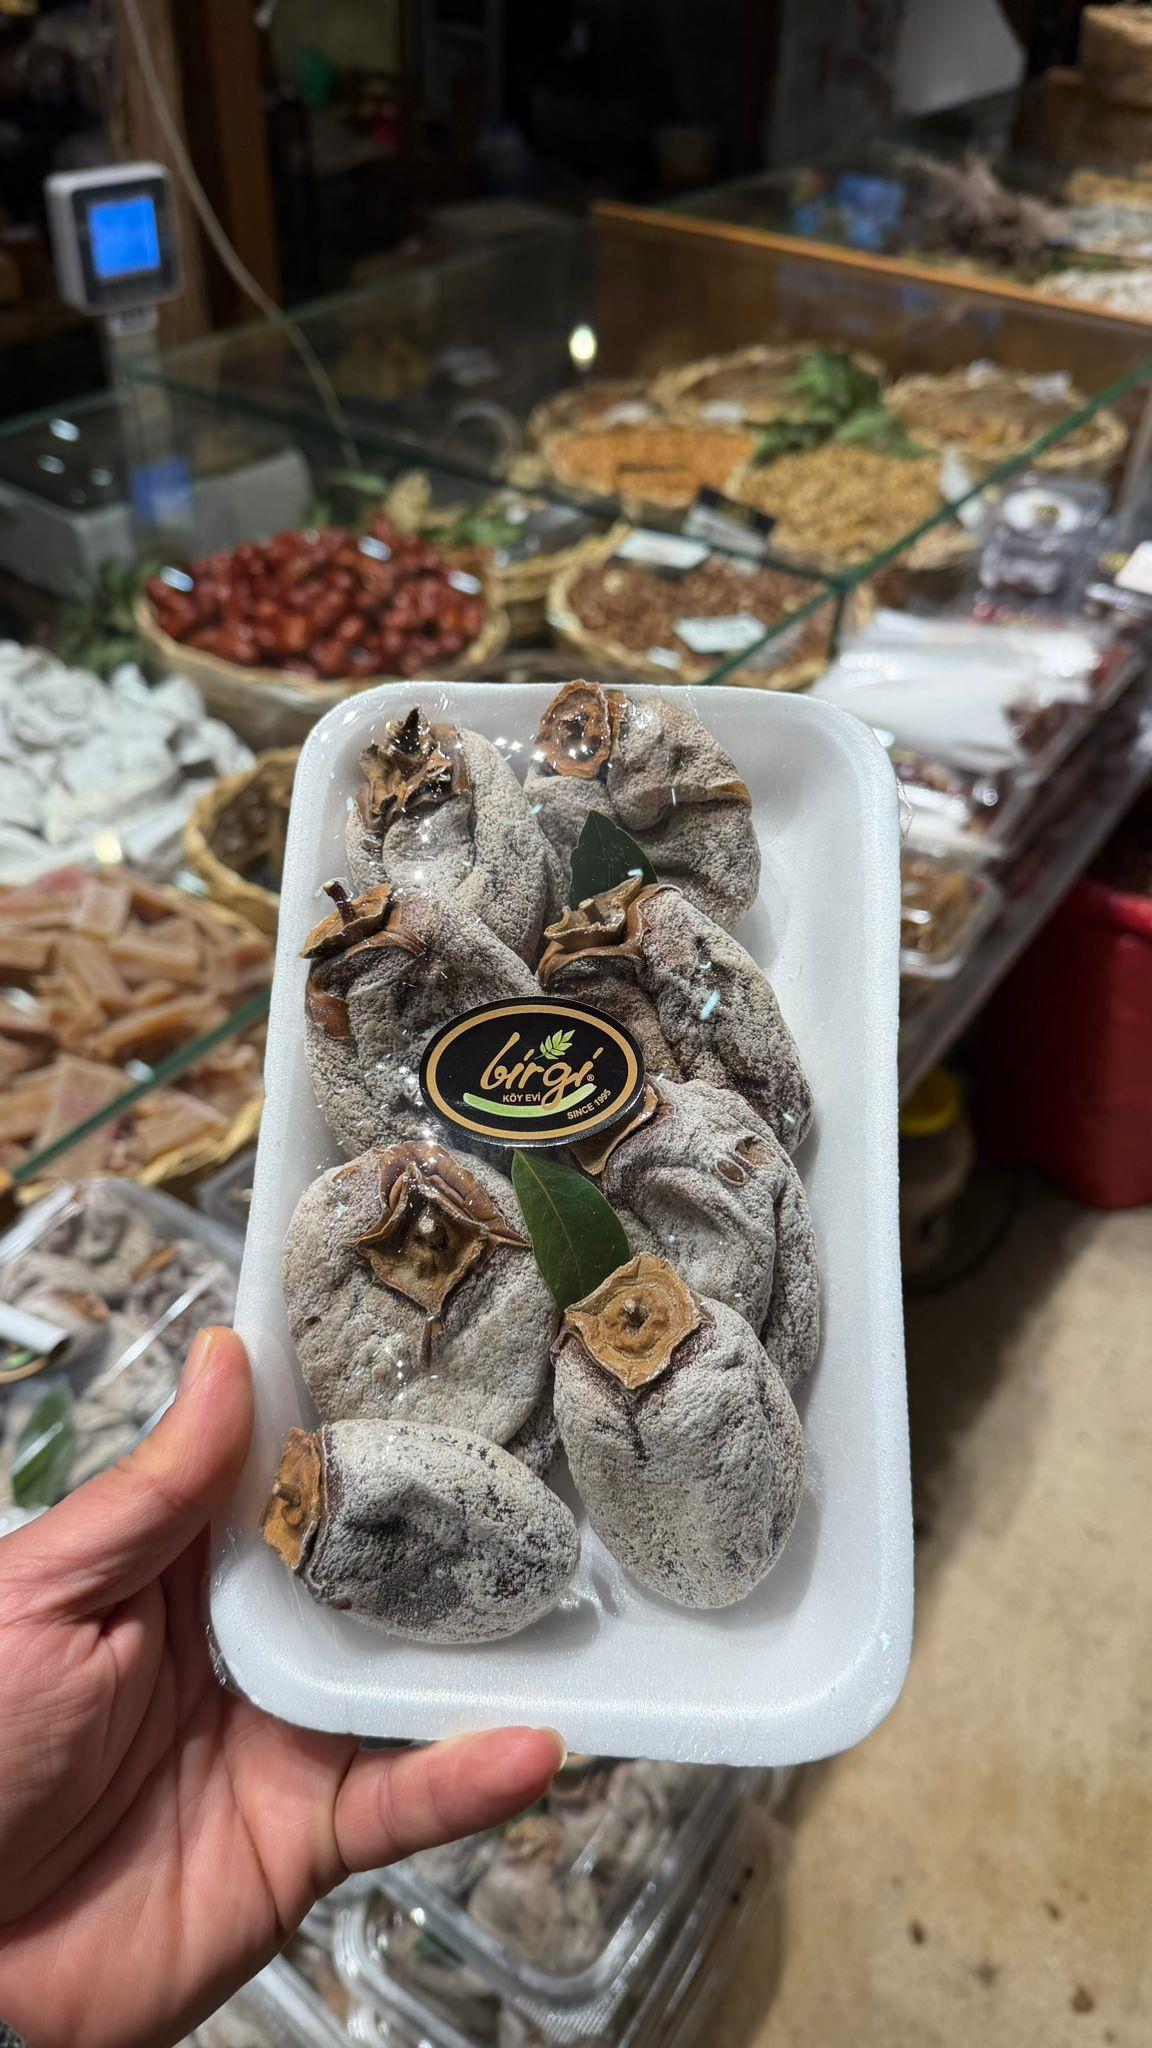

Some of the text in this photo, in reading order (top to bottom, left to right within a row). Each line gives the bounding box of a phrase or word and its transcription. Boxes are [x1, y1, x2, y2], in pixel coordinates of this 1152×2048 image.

[502, 1092, 523, 1103] KÖY
[566, 1089, 612, 1120] SINCE 1995
